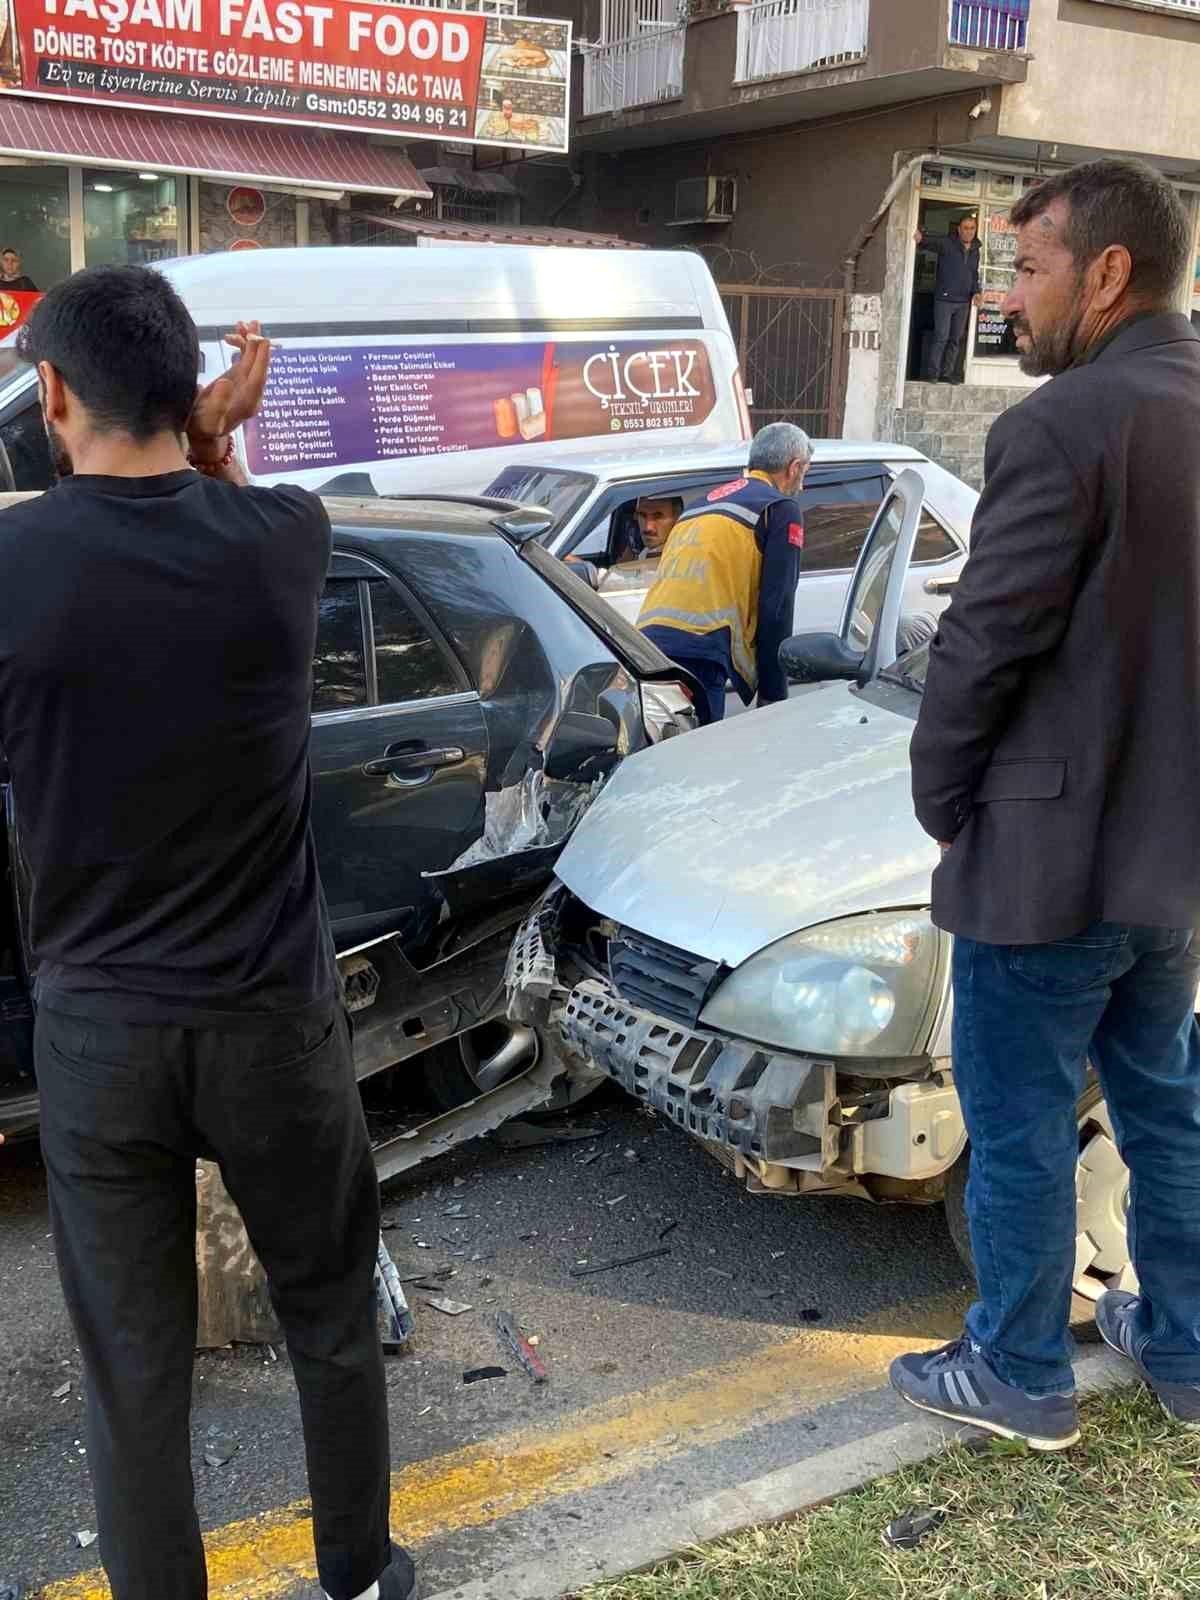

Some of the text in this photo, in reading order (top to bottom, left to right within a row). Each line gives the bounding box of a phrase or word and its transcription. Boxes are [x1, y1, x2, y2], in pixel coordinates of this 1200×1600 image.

[33, 25, 464, 101] DÖNER TOST KÖFTE GÖZLEME MENEMEN SAC TAVA
[219, 0, 333, 47] FAST
[349, 11, 470, 62] FOOD
[46, 62, 72, 81] Ev
[77, 71, 95, 84] ve
[187, 82, 238, 102] Servis
[306, 93, 386, 119] Gsm:0552
[391, 104, 421, 122] 394
[425, 108, 445, 125] 96
[448, 109, 467, 128] 21
[583, 344, 701, 409] ÇİÇEK
